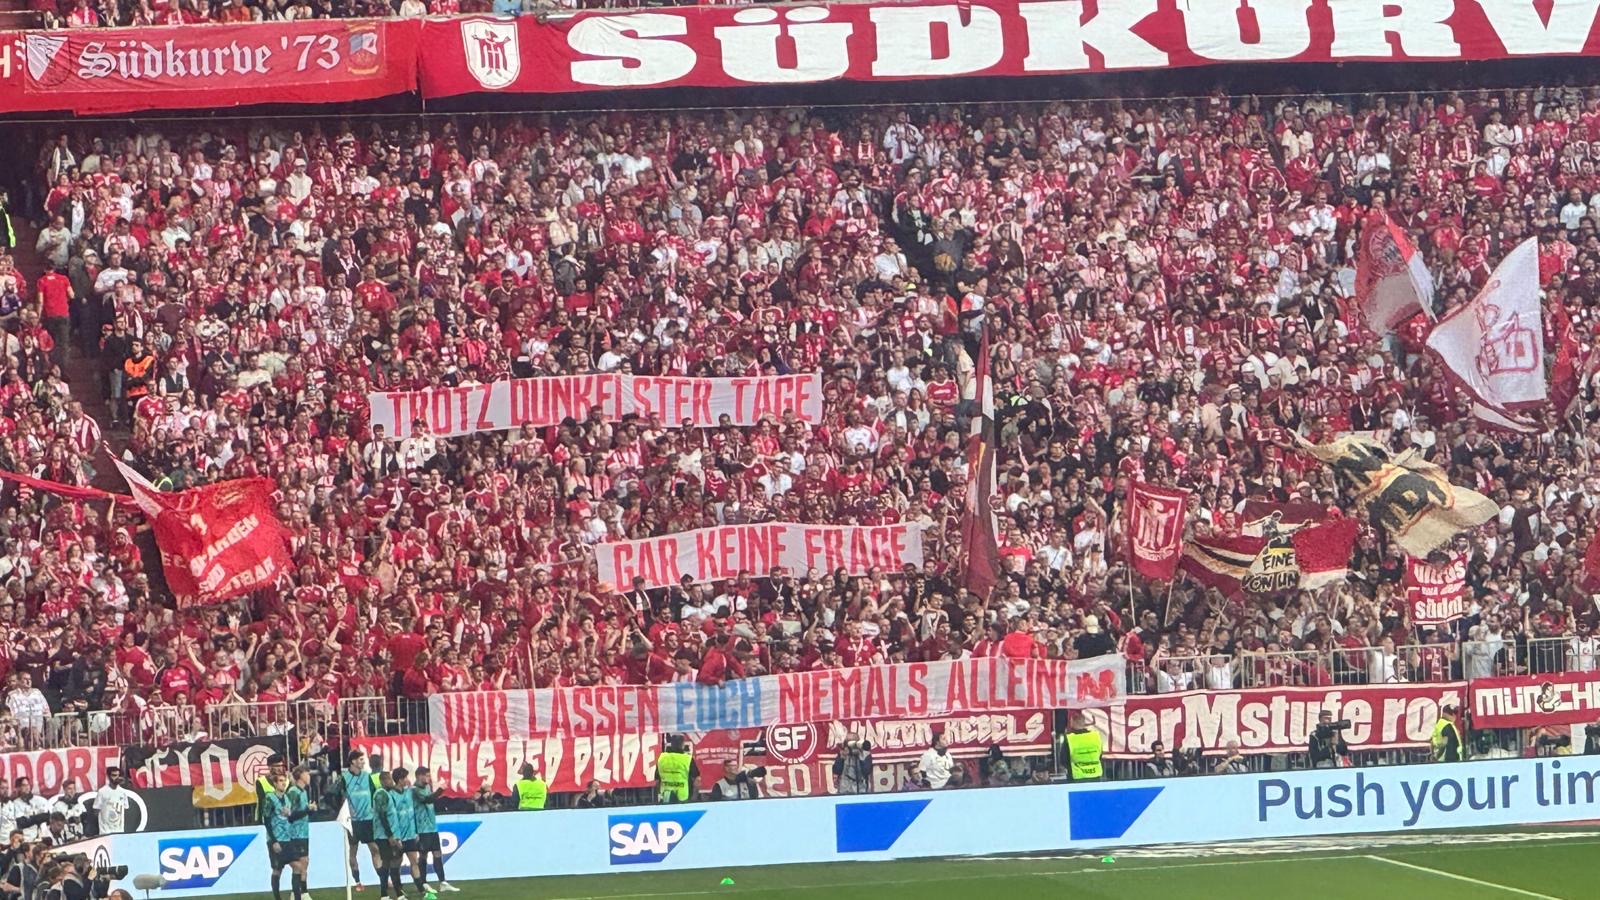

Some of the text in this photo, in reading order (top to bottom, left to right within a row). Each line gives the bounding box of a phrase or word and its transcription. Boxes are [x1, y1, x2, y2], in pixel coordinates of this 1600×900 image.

[77, 34, 341, 79] Südkurve '73
[387, 383, 495, 437] TROTZ
[731, 375, 813, 423] TAGE
[613, 526, 907, 592] GAR KEINE FRAGE
[1262, 552, 1296, 571] EINE
[443, 656, 1067, 743] WIR LASSEN EUCH NIEMALS ALLEIN!
[574, 733, 659, 786] PRIDE
[774, 726, 807, 751] SF
[0, 747, 120, 800] DORF
[1258, 772, 1385, 822] Push
[1401, 774, 1519, 826] your
[160, 845, 234, 881] SAP
[610, 821, 683, 856] SAP
